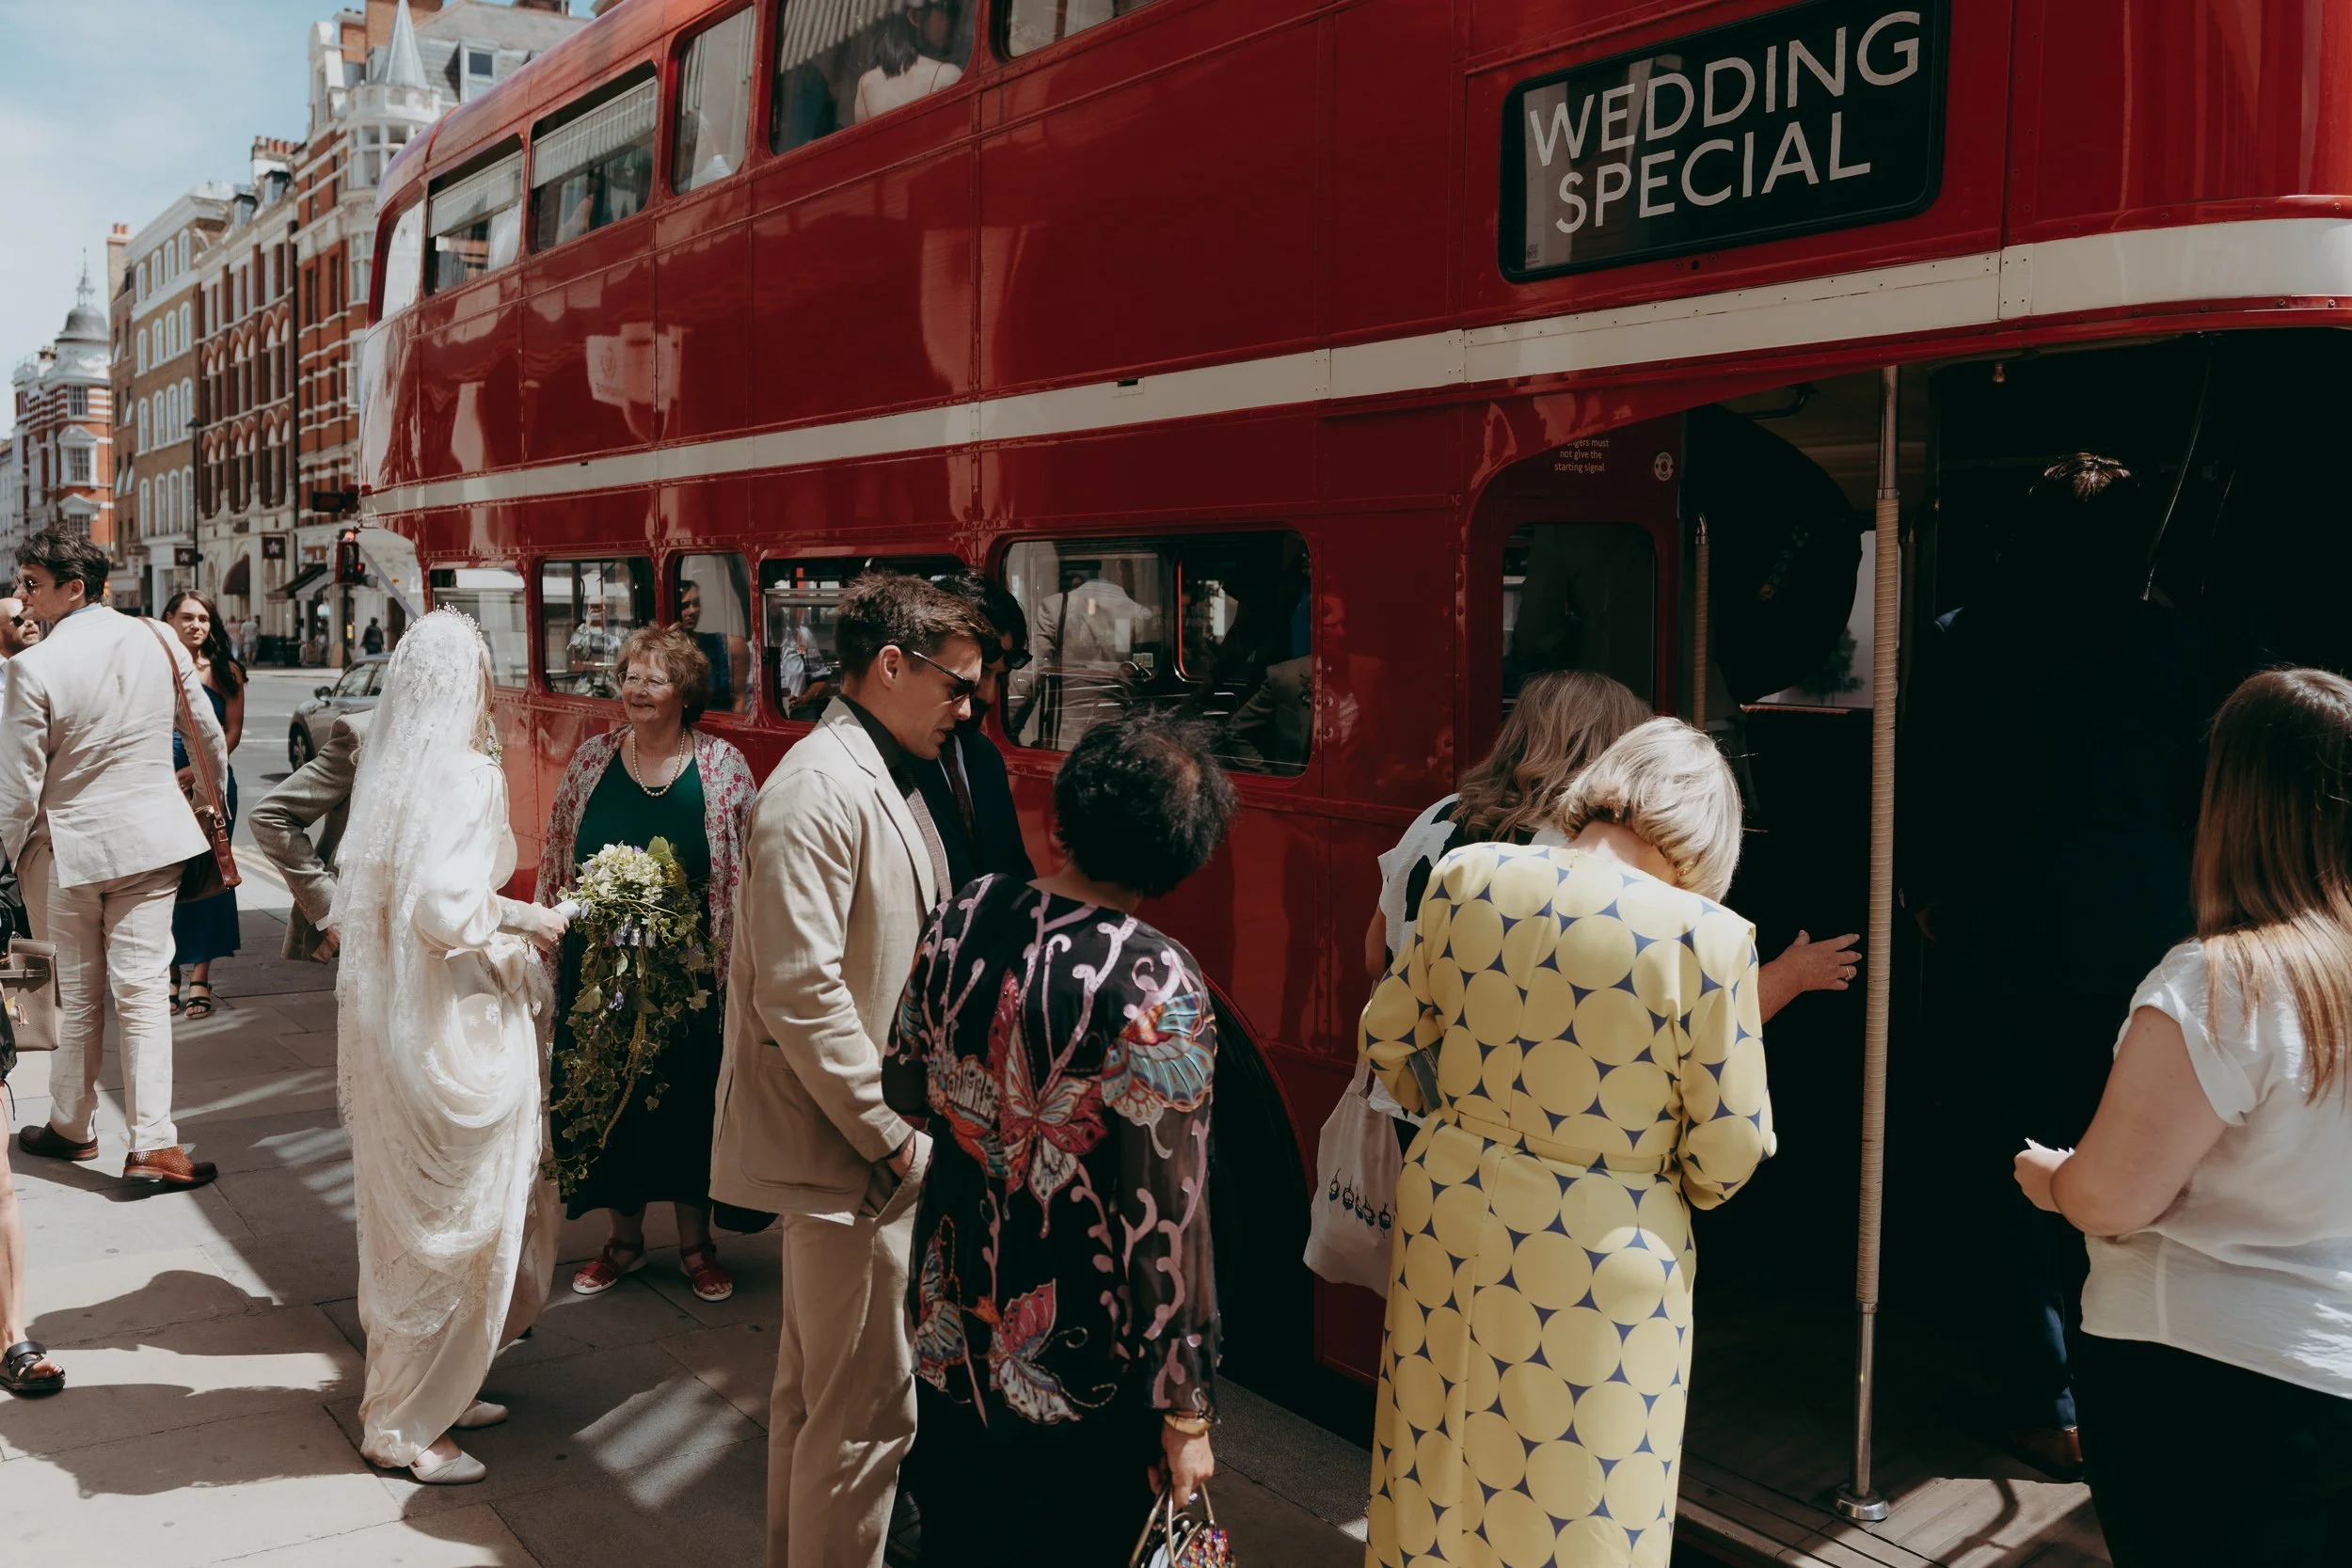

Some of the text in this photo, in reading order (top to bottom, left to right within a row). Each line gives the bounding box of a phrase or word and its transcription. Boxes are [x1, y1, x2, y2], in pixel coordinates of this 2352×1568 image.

[1530, 10, 1919, 167] WEDDING
[1555, 111, 1871, 234] SPECIAL
[1591, 439, 1610, 448] must
[1574, 450, 1589, 460] give
[1590, 450, 1602, 459] the
[1554, 462, 1605, 473] starting signal
